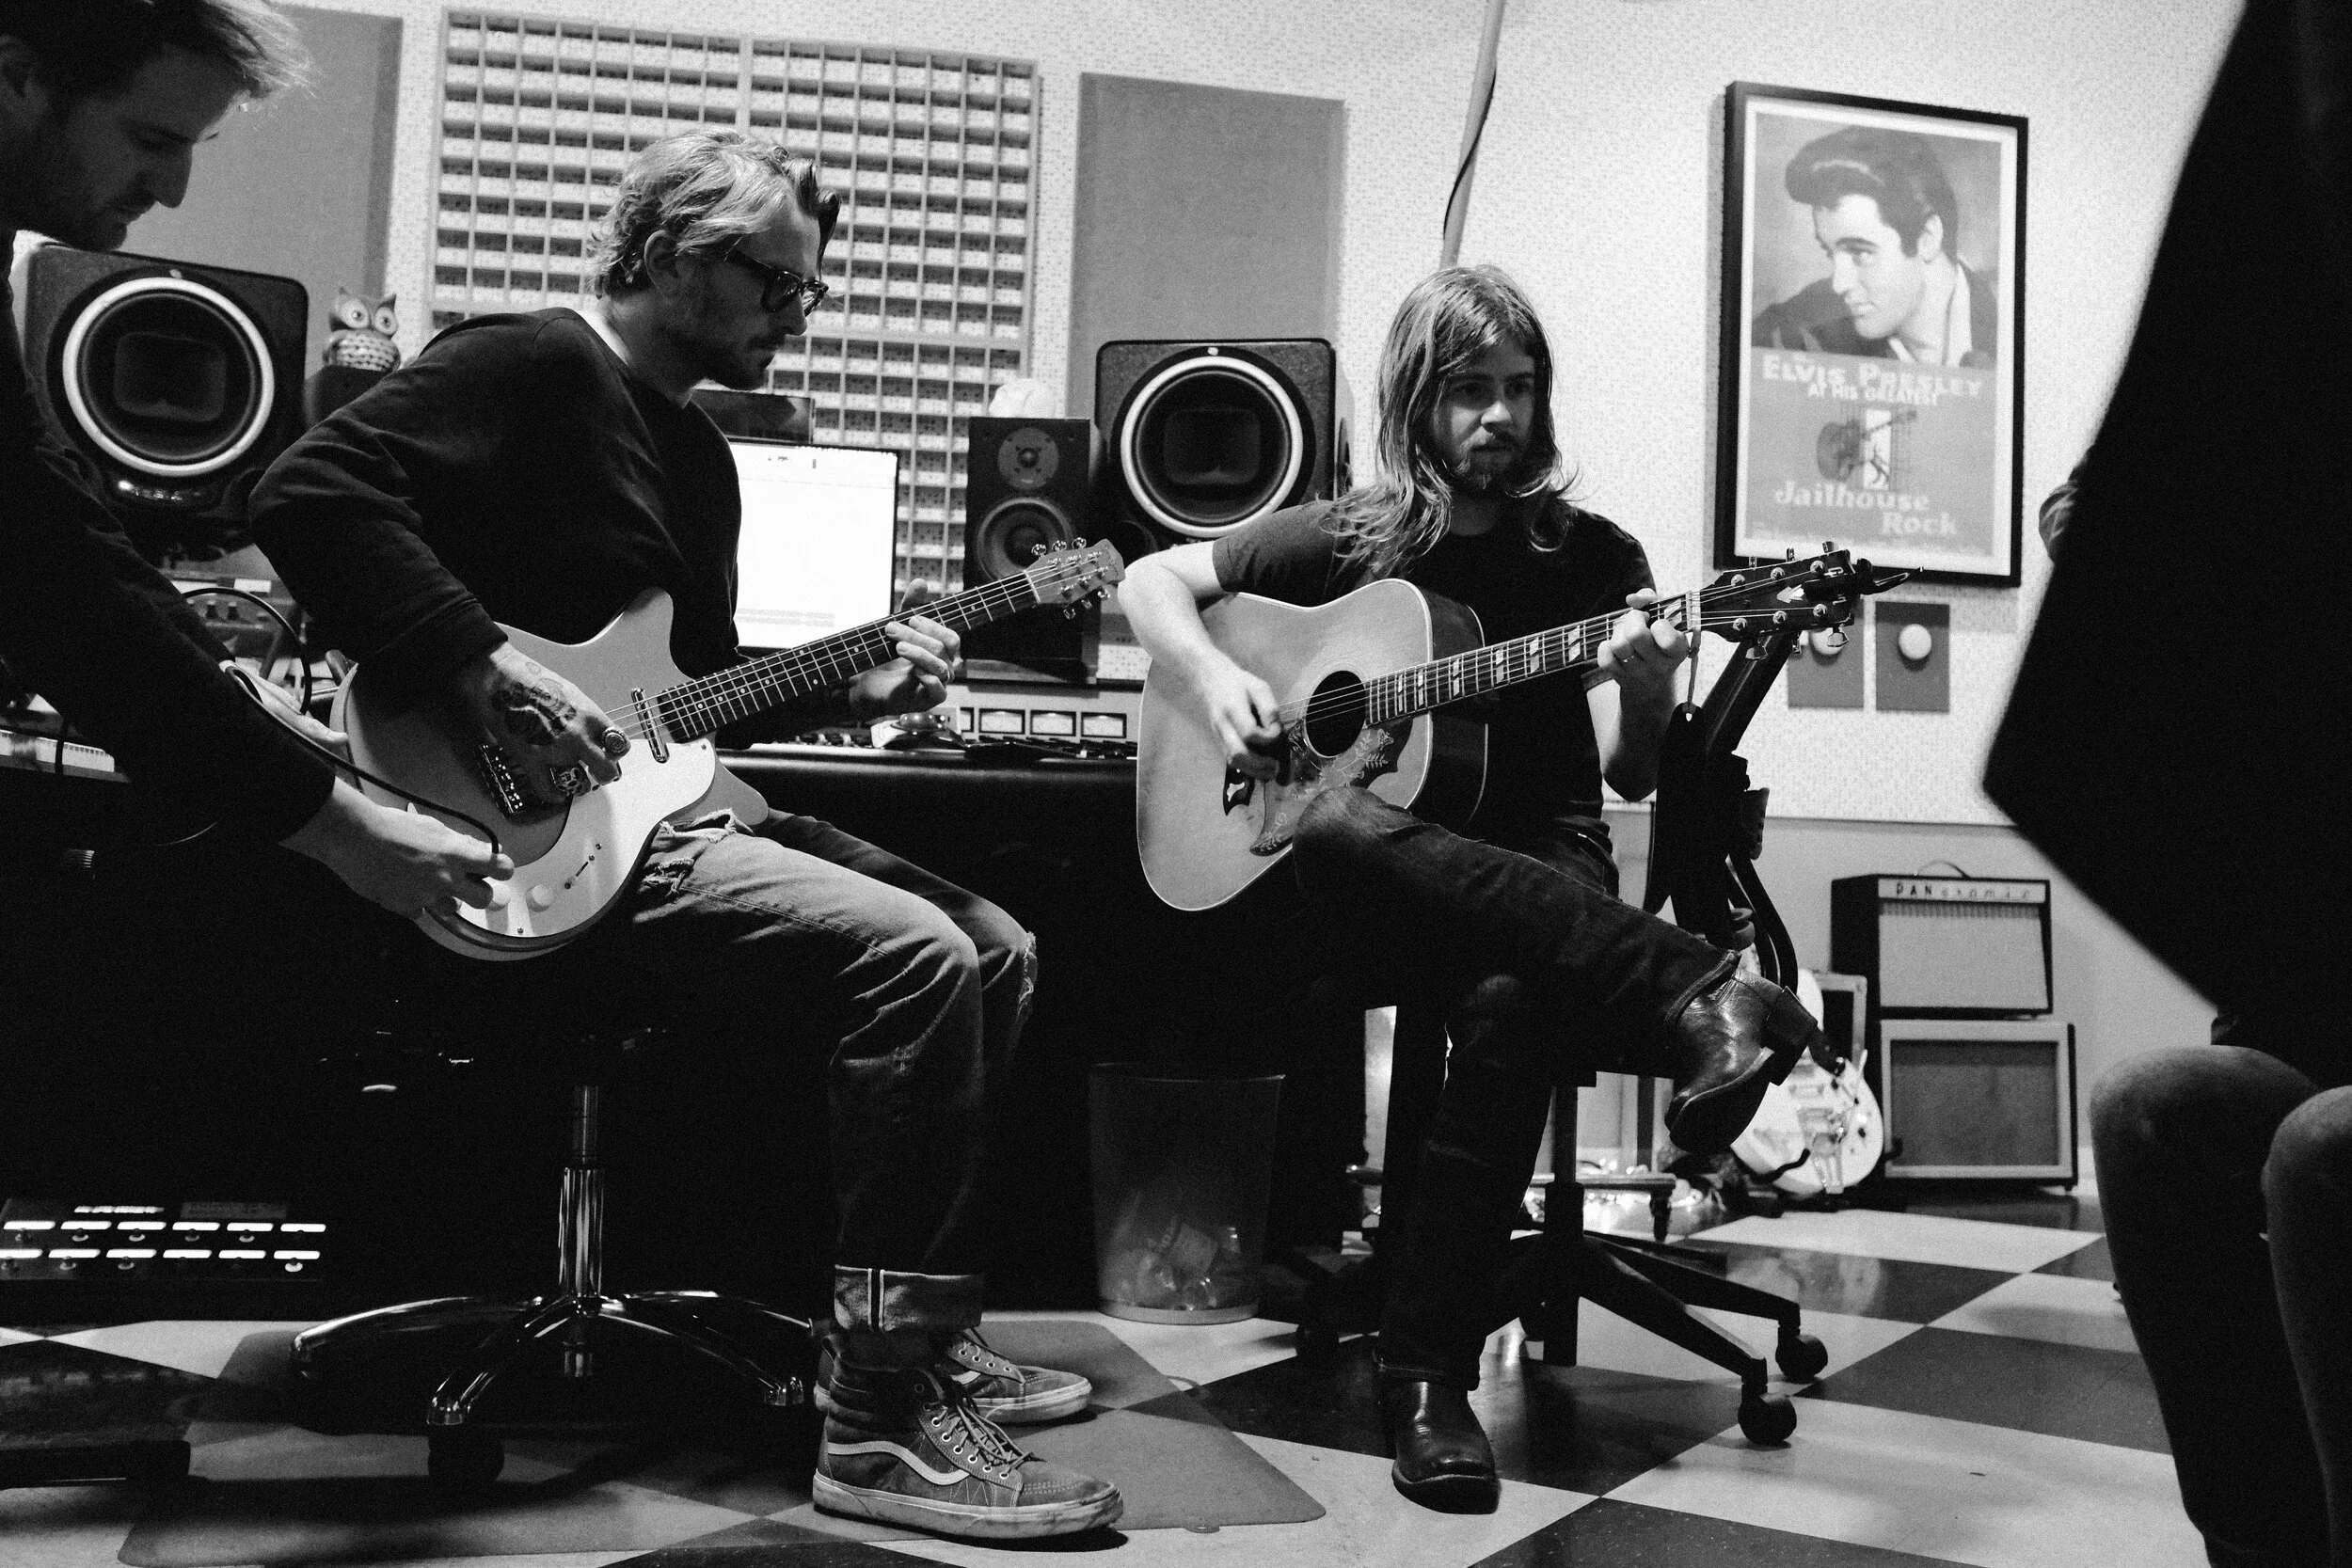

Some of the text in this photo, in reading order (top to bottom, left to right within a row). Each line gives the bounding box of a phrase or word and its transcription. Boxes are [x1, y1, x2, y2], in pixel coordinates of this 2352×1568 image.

[1762, 353, 1983, 396] ELVIS PRESLEY
[1773, 481, 1930, 511] Jailhouse
[1881, 511, 1958, 536] Rock
